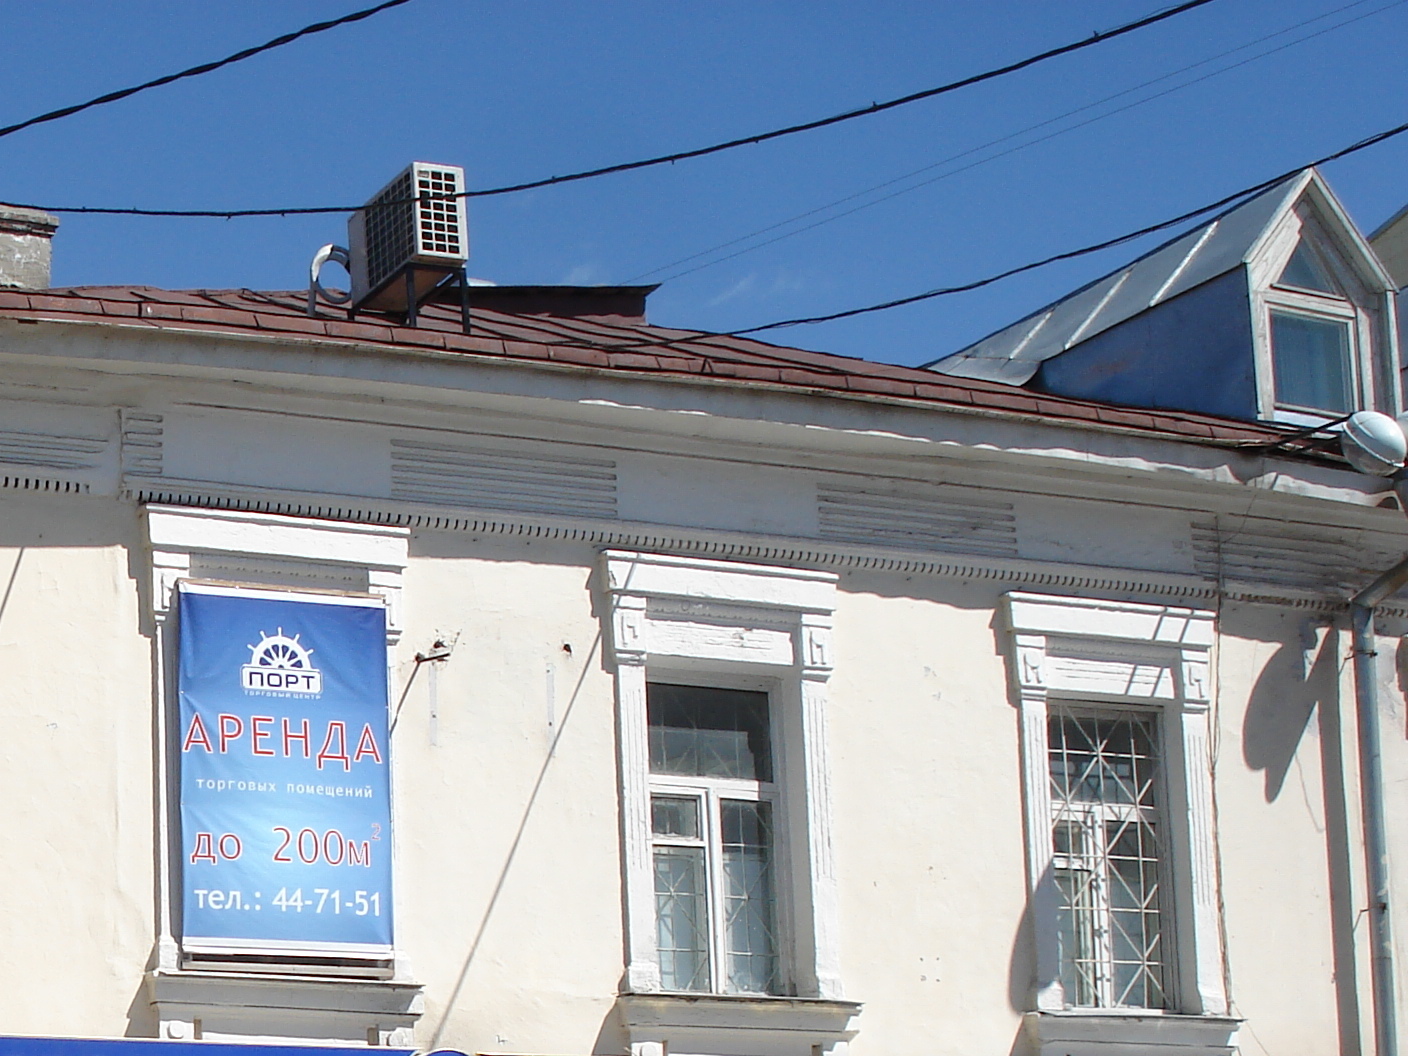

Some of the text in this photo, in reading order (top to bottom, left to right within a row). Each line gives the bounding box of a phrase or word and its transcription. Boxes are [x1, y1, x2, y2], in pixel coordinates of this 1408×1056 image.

[249, 671, 316, 690] ПОРТ
[182, 712, 383, 772] АРЕНДА
[196, 778, 373, 799] торговых помещений
[194, 886, 382, 917] тел.: 44-71-51
